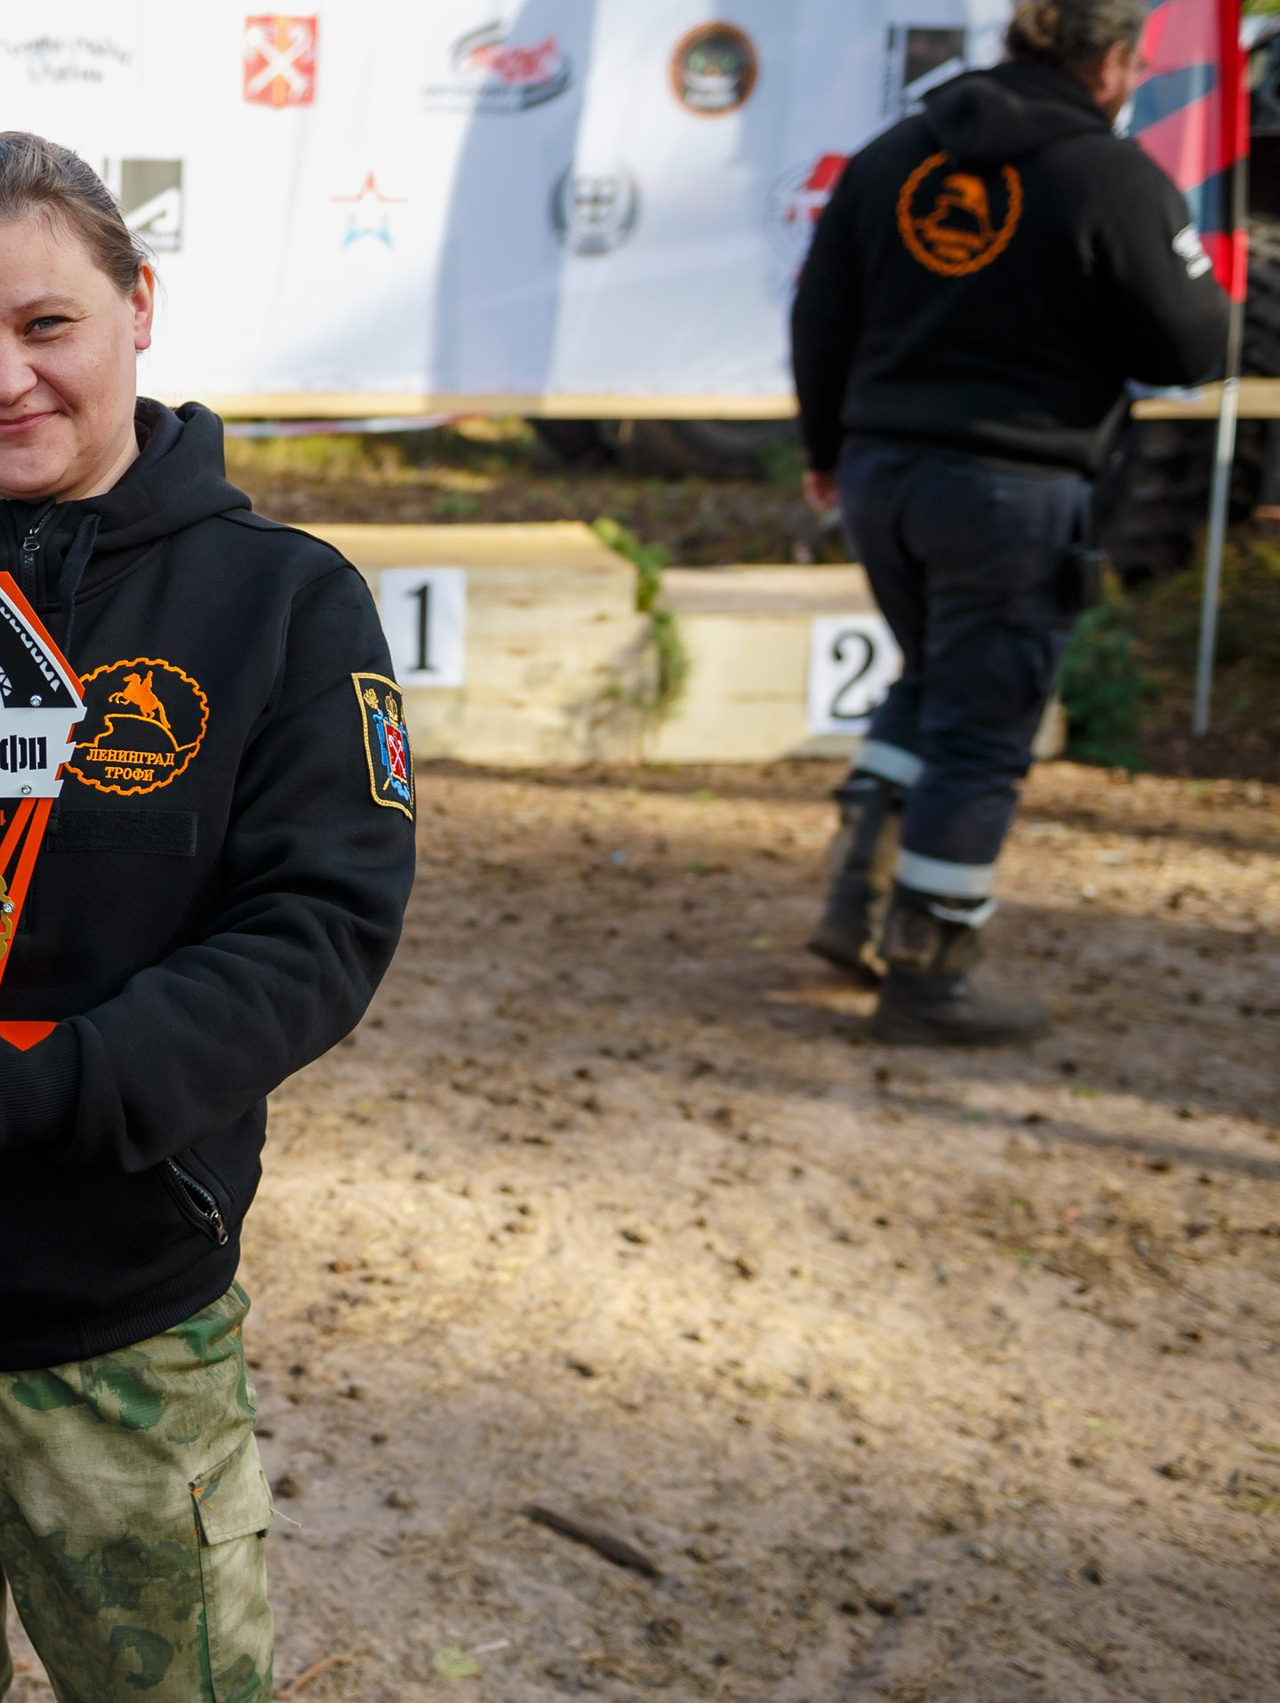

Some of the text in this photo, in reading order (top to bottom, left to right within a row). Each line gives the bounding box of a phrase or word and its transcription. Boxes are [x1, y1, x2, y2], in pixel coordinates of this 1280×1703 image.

[406, 581, 437, 673] 1
[830, 630, 875, 720] 2
[86, 748, 176, 767] ЛЕНИНГРАД
[104, 766, 155, 782] ТРОФИ
